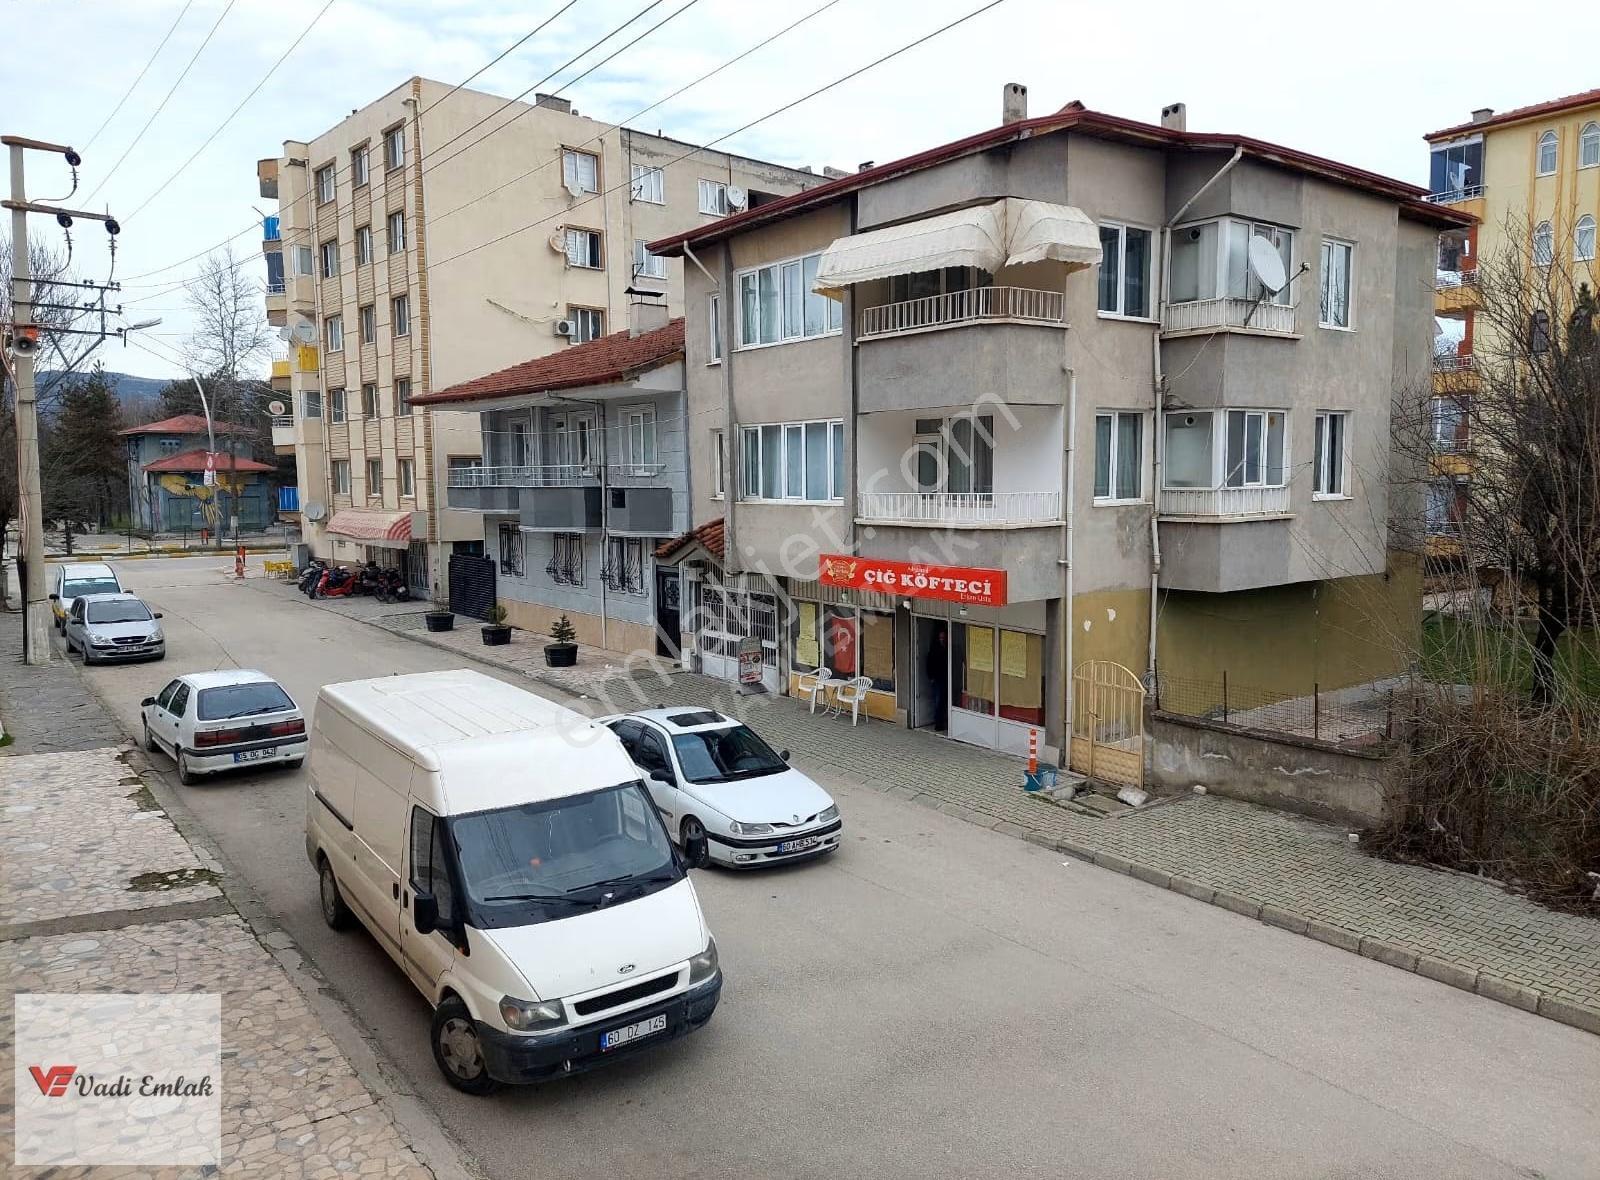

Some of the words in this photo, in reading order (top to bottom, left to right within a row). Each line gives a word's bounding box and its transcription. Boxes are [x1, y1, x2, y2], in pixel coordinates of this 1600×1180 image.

[864, 568, 897, 585] ÇİĞ
[901, 572, 992, 596] KÖFTECİ
[608, 1031, 620, 1045] 60
[628, 1023, 639, 1039] DZ
[648, 1016, 665, 1032] 145
